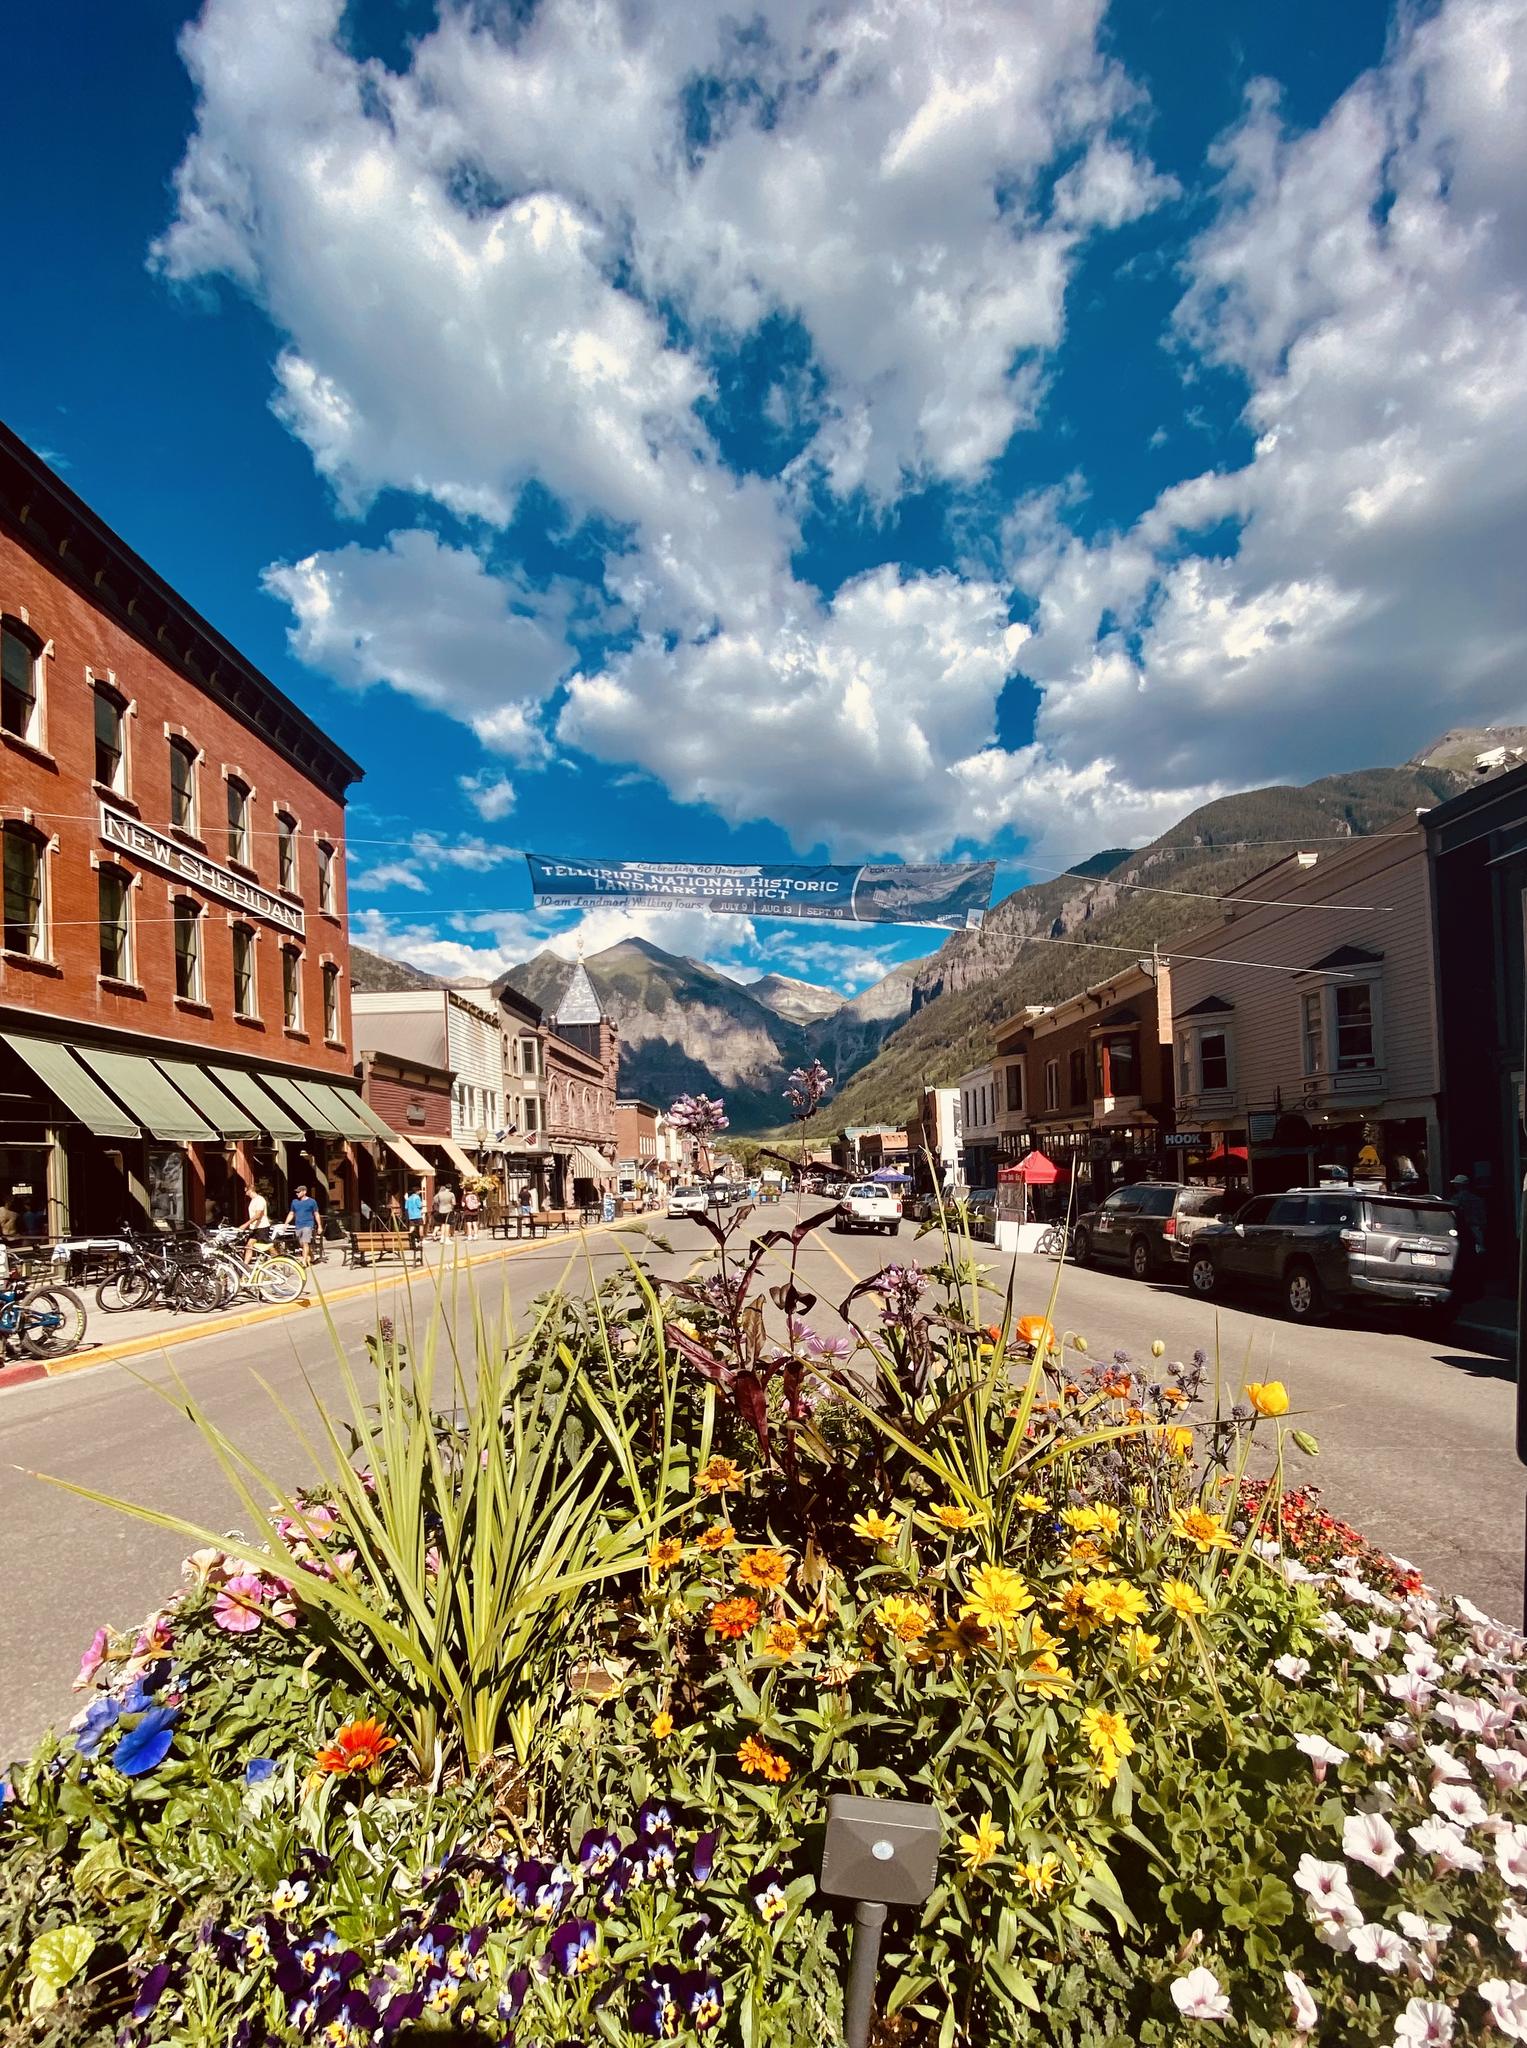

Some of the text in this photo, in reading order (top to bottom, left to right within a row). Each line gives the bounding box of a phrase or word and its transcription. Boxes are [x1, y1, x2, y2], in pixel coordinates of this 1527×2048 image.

[106, 814, 299, 928] NEW SHERIDAN
[637, 863, 695, 875] Celebrating
[697, 866, 712, 874] 60
[541, 866, 839, 892] TELLURIDE NATIONAL HISTORIC
[595, 880, 789, 900] LANDMARK DISTRICT
[720, 902, 748, 911] JULY 9
[783, 905, 792, 914] 13
[834, 908, 843, 917] 10
[1165, 1134, 1201, 1145] HOOK
